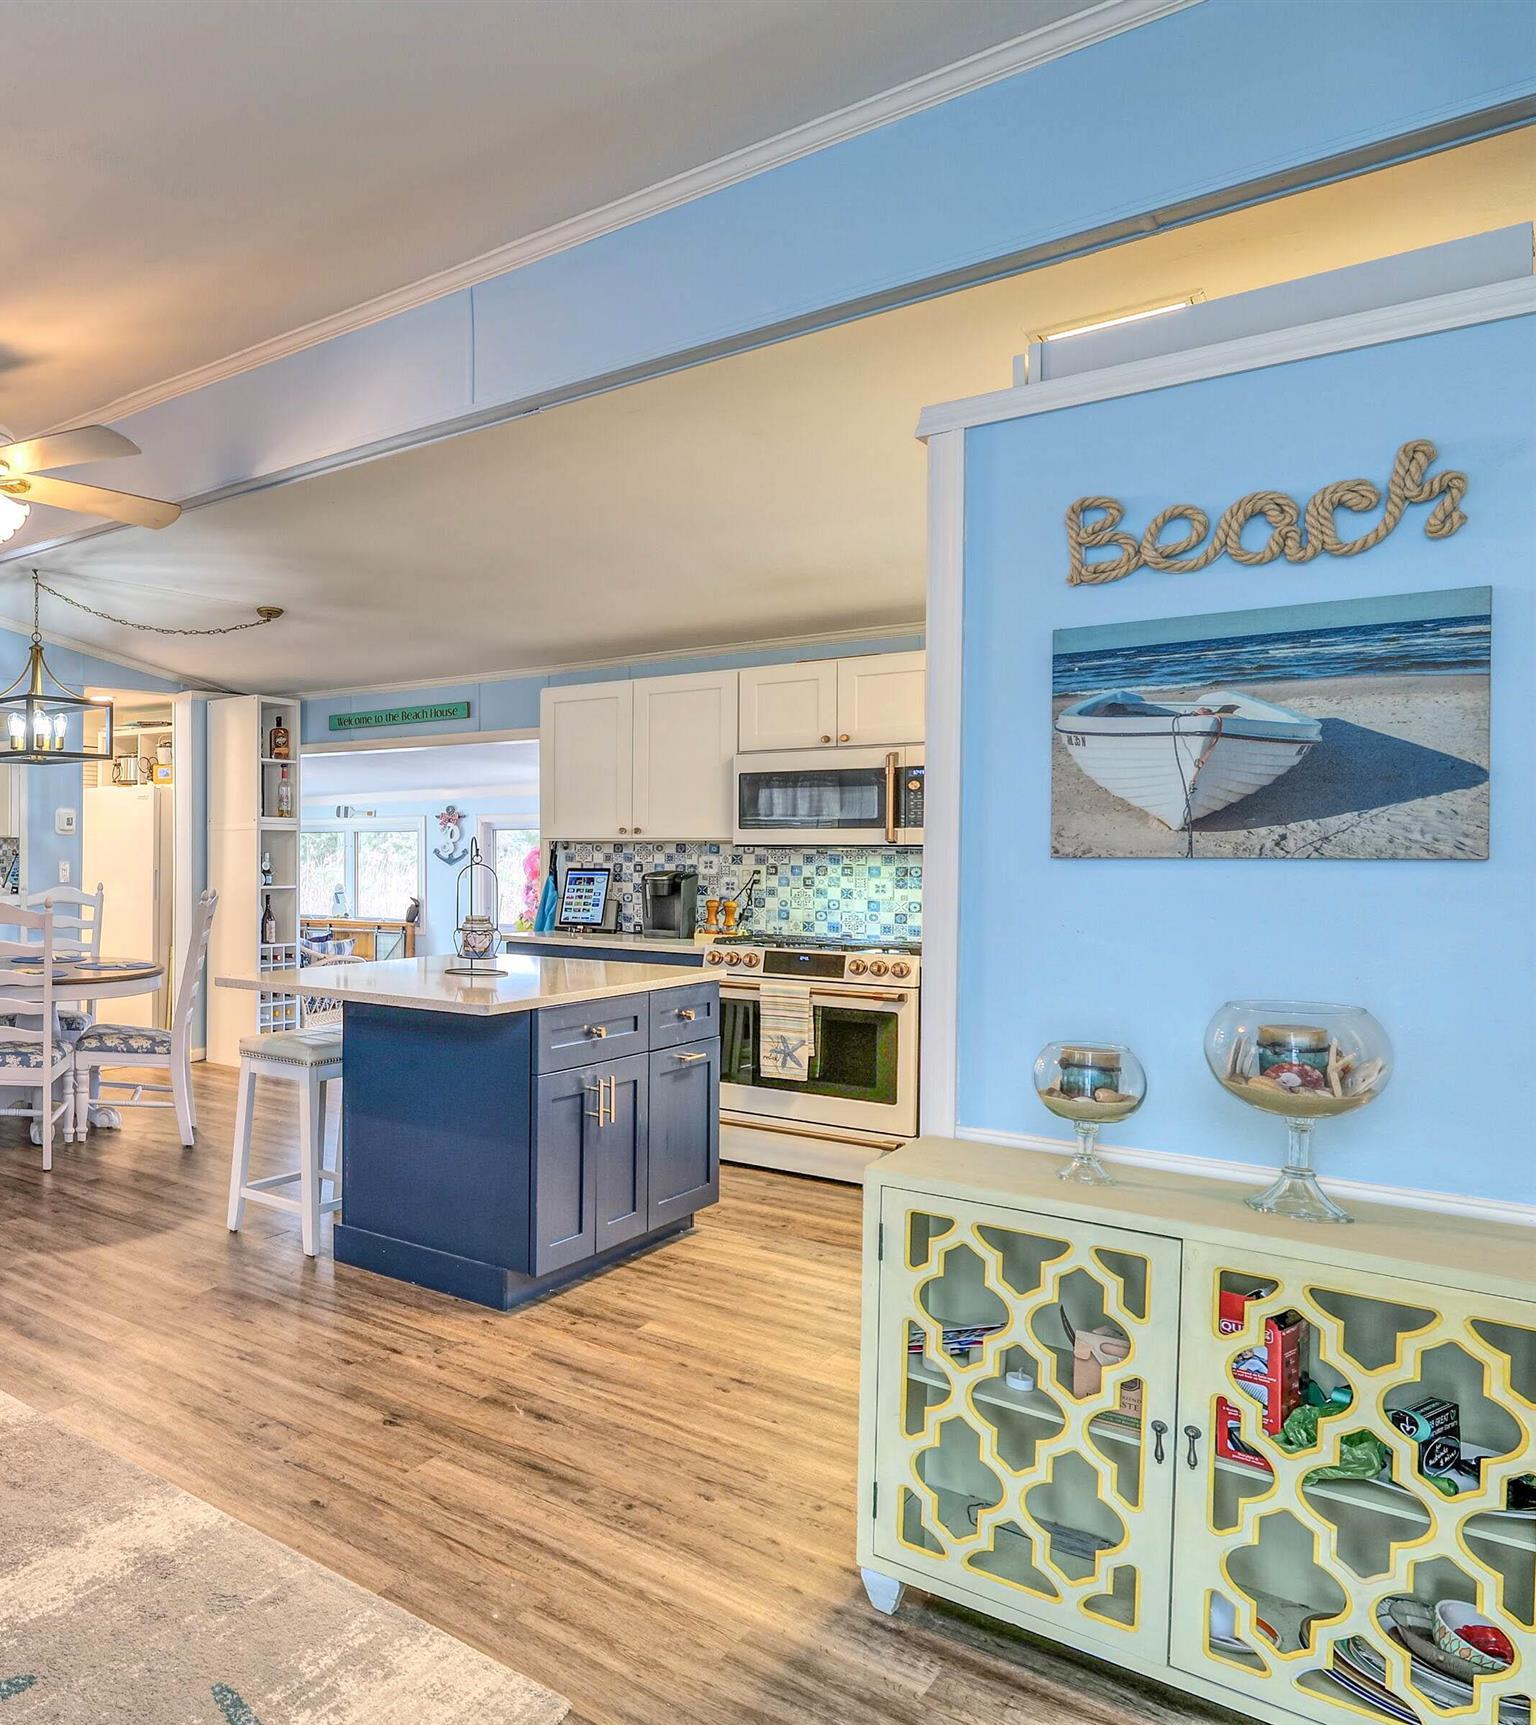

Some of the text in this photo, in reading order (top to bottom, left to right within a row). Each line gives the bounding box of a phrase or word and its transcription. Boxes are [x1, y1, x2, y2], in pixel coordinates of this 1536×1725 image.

[1066, 439, 1468, 586] Beach
[336, 706, 458, 727] Welcome to the Beach House
